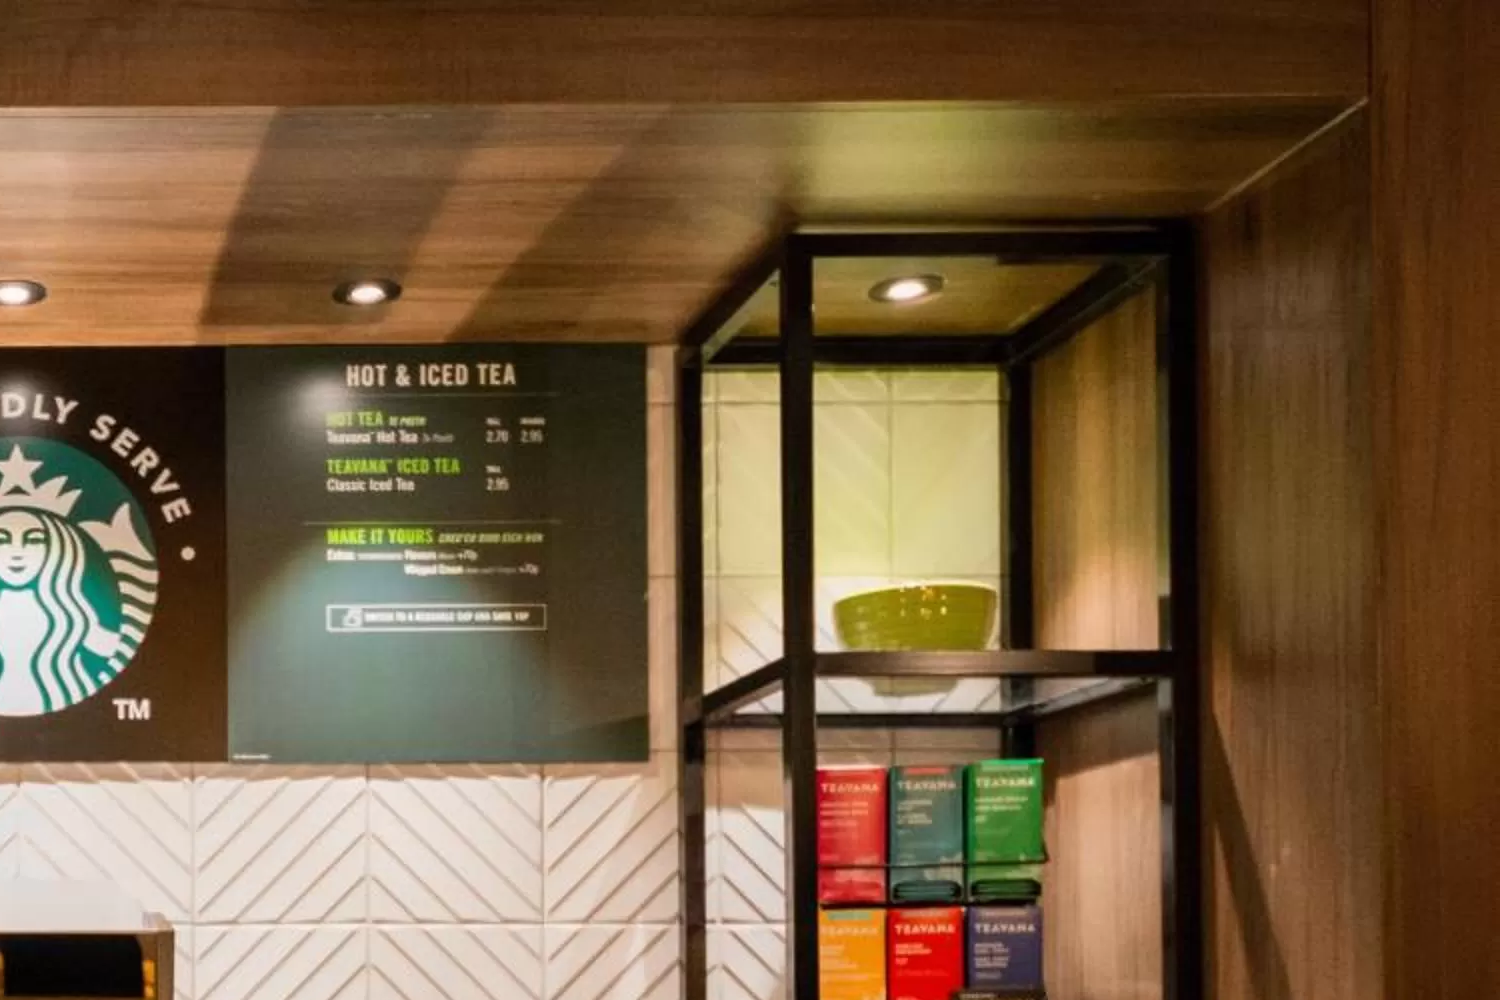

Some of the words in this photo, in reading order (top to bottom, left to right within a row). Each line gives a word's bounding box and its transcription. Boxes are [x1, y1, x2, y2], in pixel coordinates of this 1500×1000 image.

[346, 364, 387, 387] HOT
[395, 364, 411, 387] &
[419, 364, 469, 387] ICED
[476, 364, 517, 387] TEA
[359, 411, 384, 427] TEA
[377, 430, 396, 443] Hot
[399, 430, 419, 443] Tea
[88, 413, 193, 524] SERVE
[397, 459, 430, 474] ICED
[434, 459, 461, 474] TEA
[327, 478, 366, 491] Classic
[369, 478, 392, 491] Iced
[396, 478, 415, 491] Tea
[327, 529, 367, 544] MAKE
[371, 529, 383, 544] IT
[388, 529, 434, 544] YOURS
[112, 698, 151, 720] TM
[821, 782, 879, 793] TEAVANA
[976, 777, 1035, 788] TEAVANA
[895, 924, 955, 935] TEAVANA
[976, 923, 1036, 933] TEAVANA
